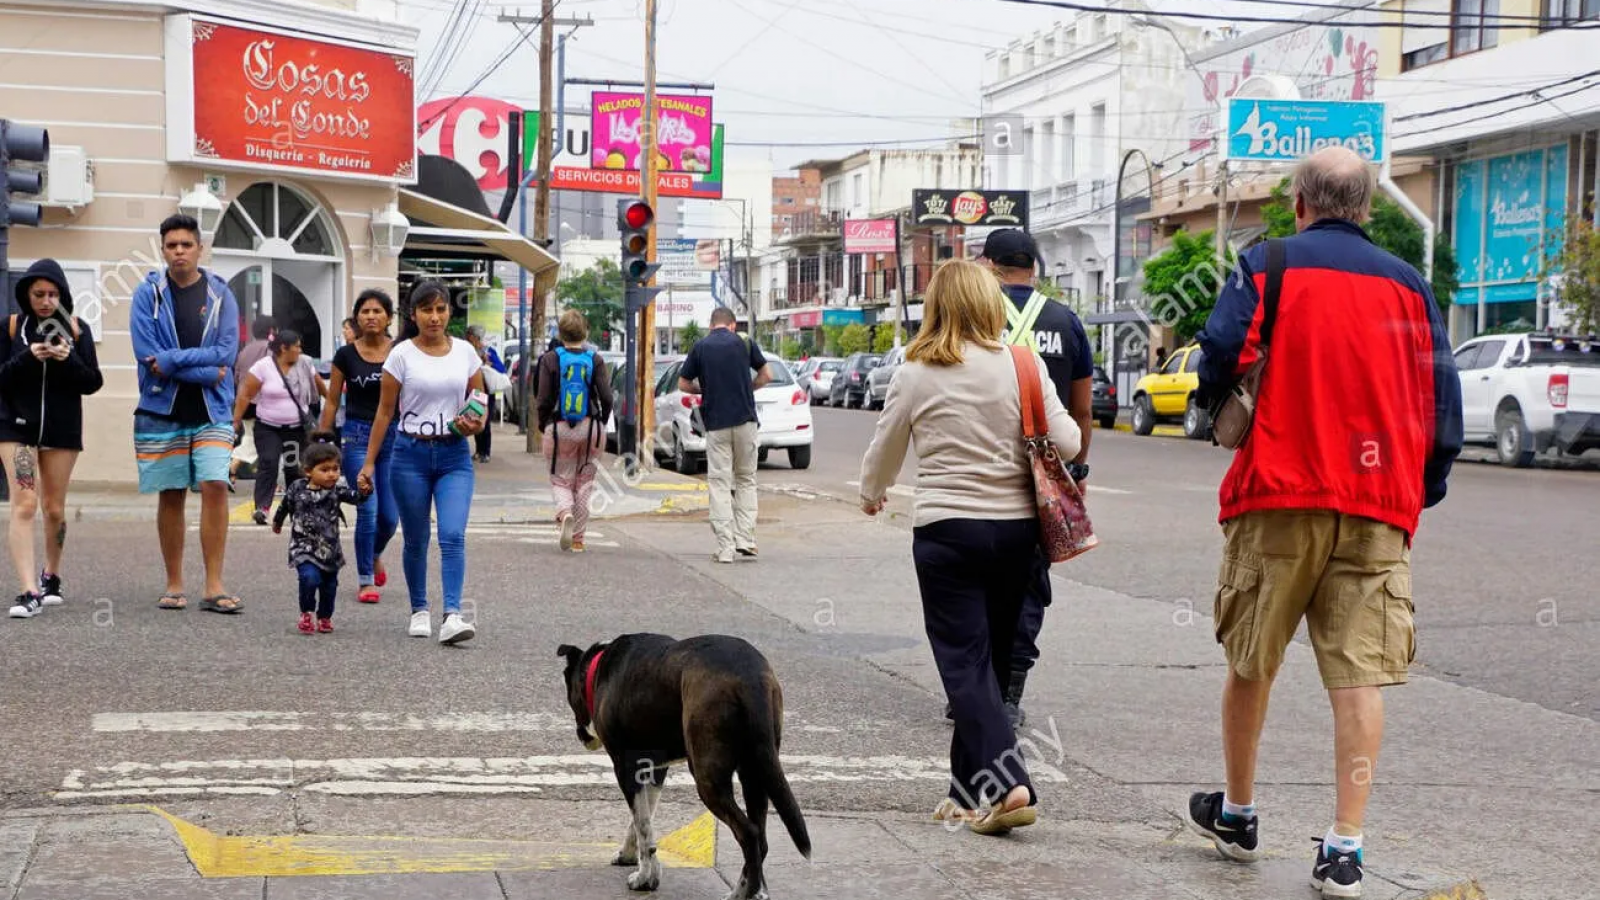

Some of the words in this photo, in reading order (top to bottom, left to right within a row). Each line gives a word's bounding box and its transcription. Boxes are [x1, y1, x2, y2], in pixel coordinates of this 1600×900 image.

[243, 39, 370, 102] Cosas
[244, 89, 283, 128] del
[291, 100, 370, 139] Conde
[598, 98, 641, 113] HELADOS
[558, 169, 623, 185] SERVICIOS
